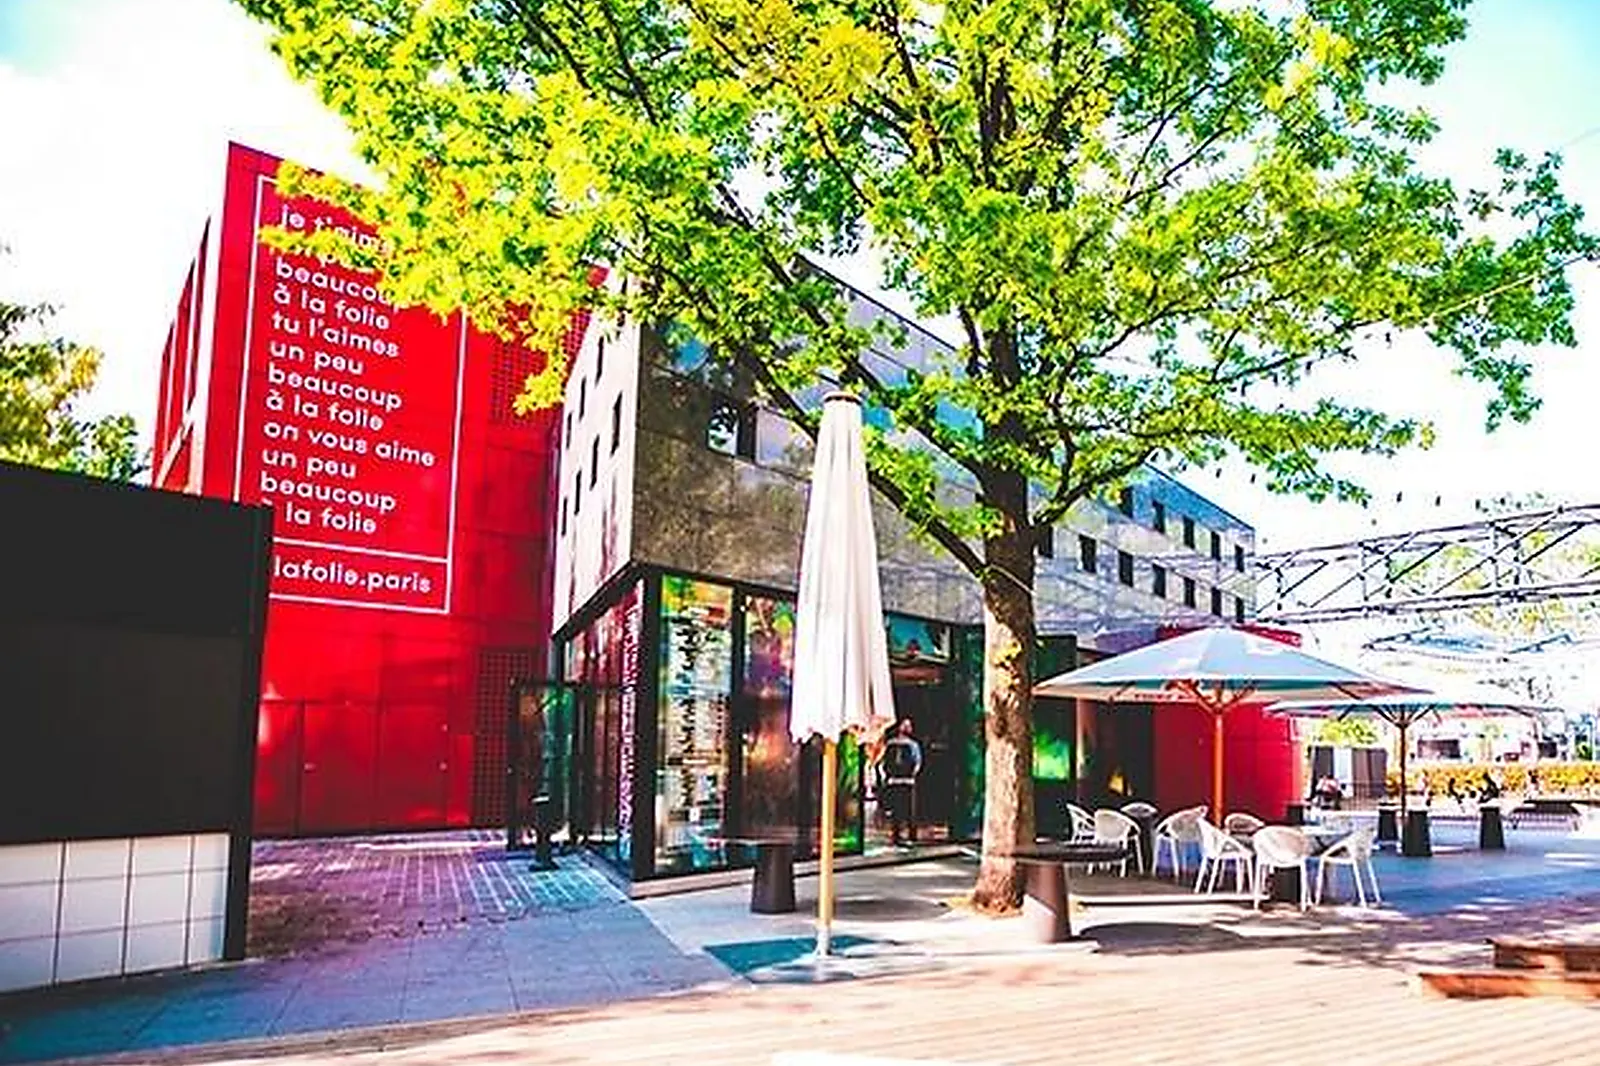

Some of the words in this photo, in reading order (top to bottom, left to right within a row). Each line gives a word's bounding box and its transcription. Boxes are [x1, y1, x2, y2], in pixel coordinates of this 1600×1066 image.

[276, 257, 399, 312] beaucou
[273, 283, 291, 305] à
[301, 290, 326, 315] la
[334, 300, 390, 330] folie
[271, 312, 300, 334] tu
[309, 318, 400, 358] l'aimes
[270, 341, 304, 361] un
[314, 351, 364, 376] peu
[268, 364, 403, 412] beaucoup
[266, 389, 284, 411] à
[294, 395, 319, 417] la
[329, 404, 384, 431] folie
[262, 449, 297, 468] un
[307, 457, 357, 479] peu
[264, 422, 299, 441] on
[307, 429, 367, 453] vous
[375, 440, 436, 467] aime
[260, 471, 396, 513] beaucoup
[286, 502, 311, 525] la
[321, 510, 377, 534] folie
[274, 556, 433, 594] lafolie.paris
